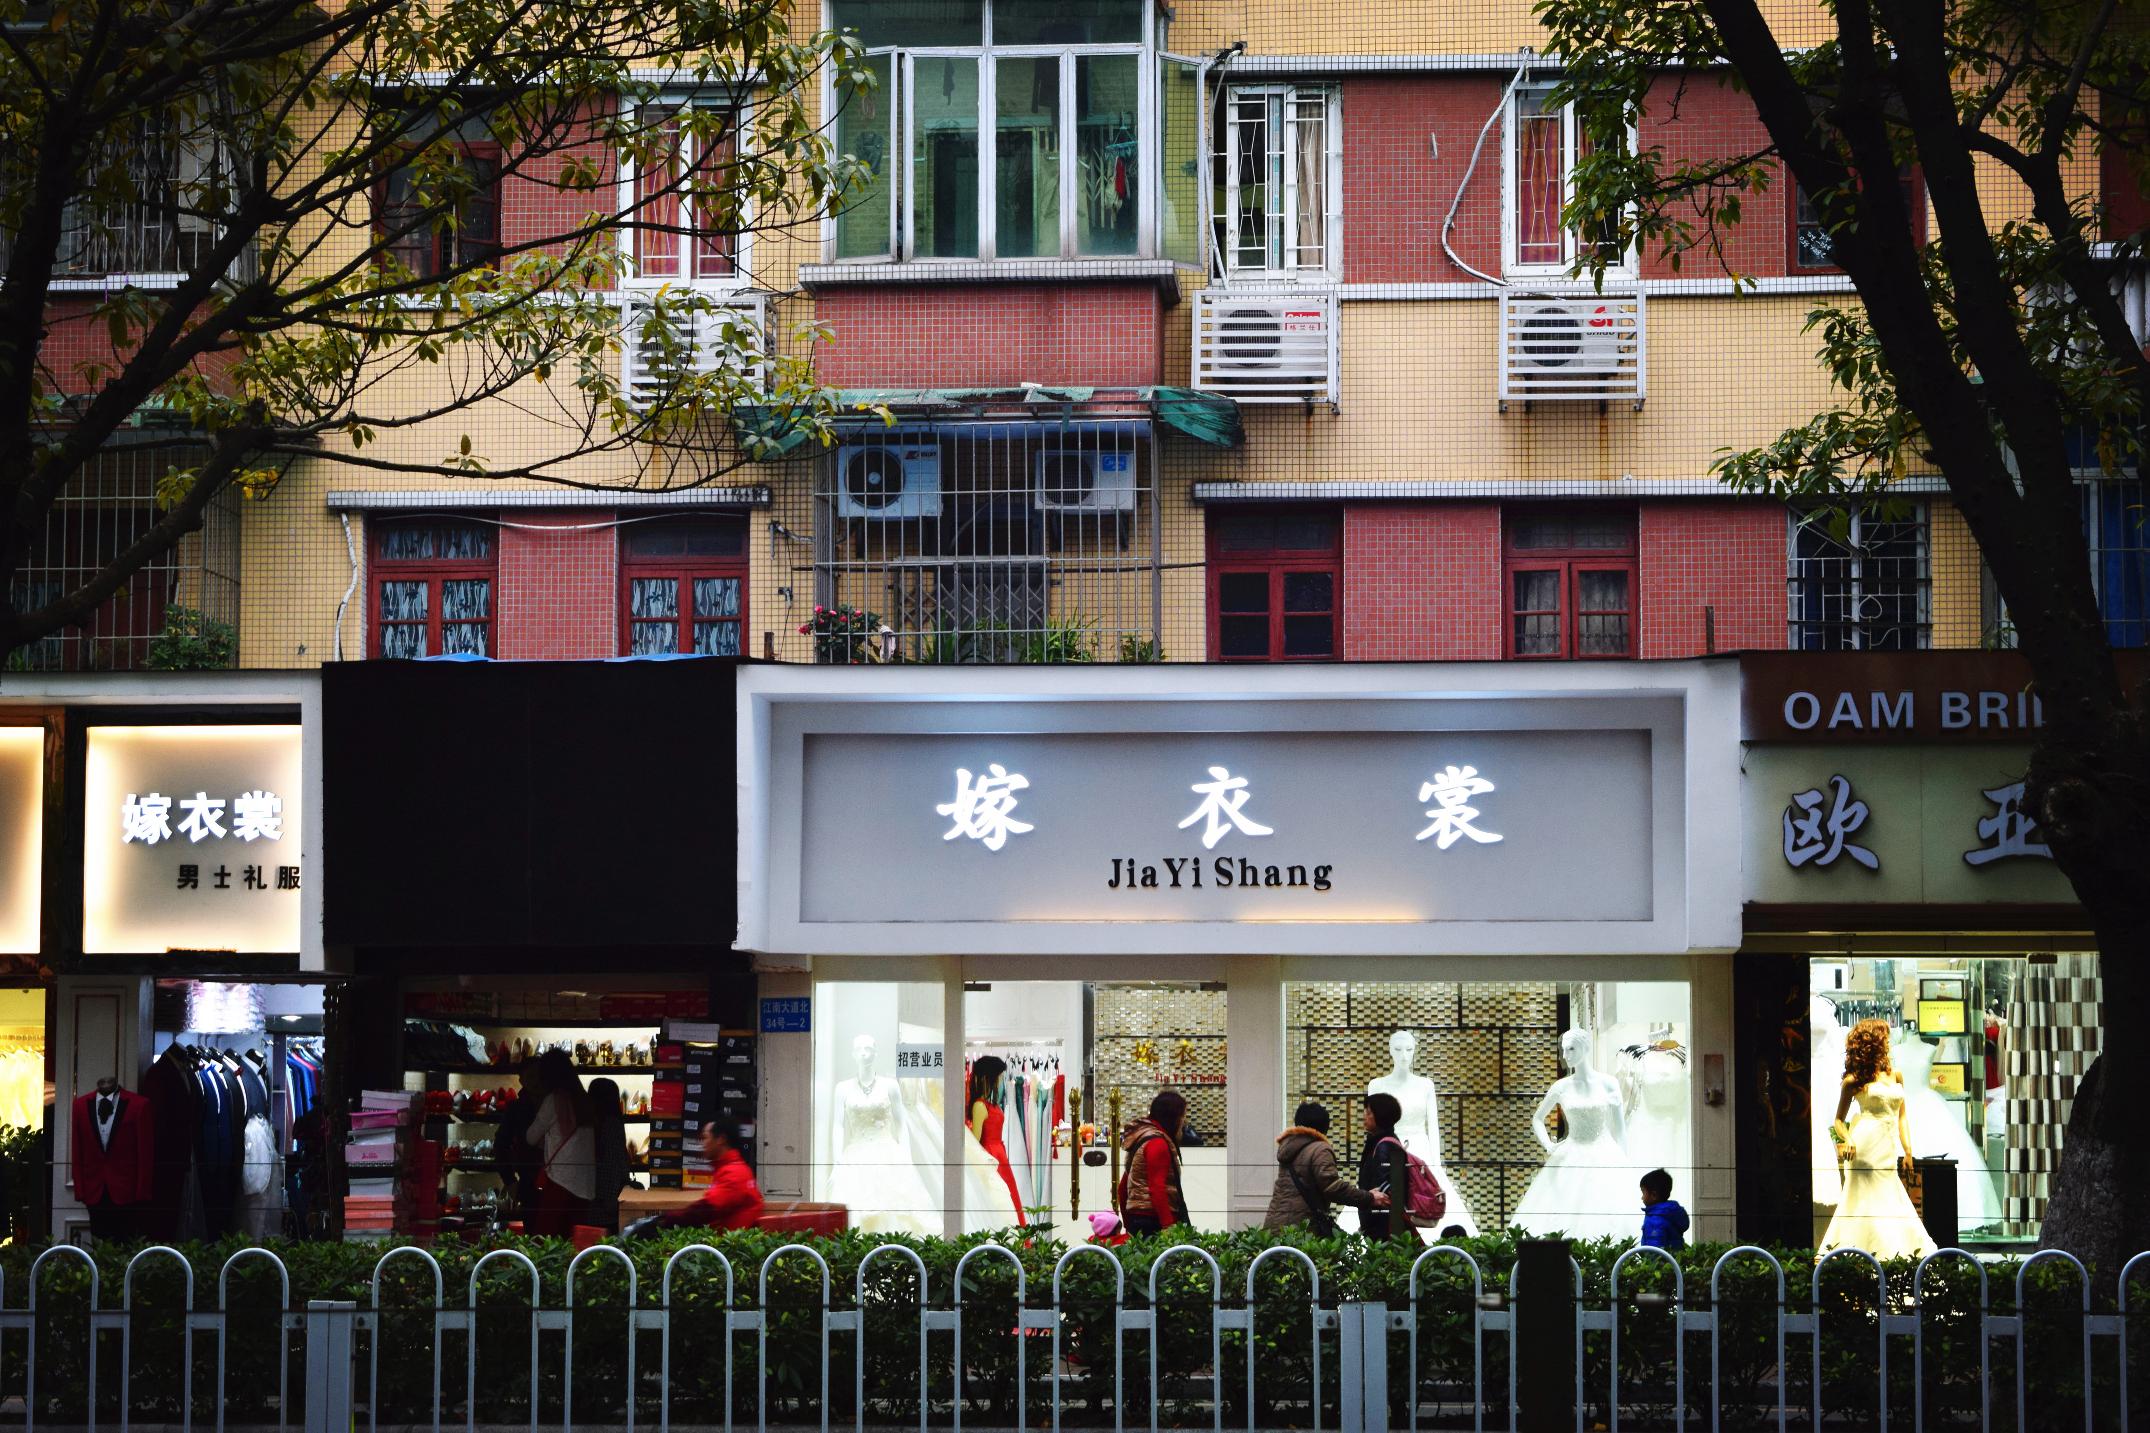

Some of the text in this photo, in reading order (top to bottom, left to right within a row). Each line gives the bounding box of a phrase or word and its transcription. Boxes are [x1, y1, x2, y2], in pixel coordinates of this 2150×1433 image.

[1783, 690, 1915, 731] OAM
[121, 790, 283, 845] 嫁衣裳
[936, 763, 1504, 852] 嫁衣裳
[1782, 774, 2054, 871] 欧亚
[177, 864, 301, 890] 男士礼服
[763, 999, 808, 1014] 江南大道北
[897, 1051, 943, 1068] 招营业员
